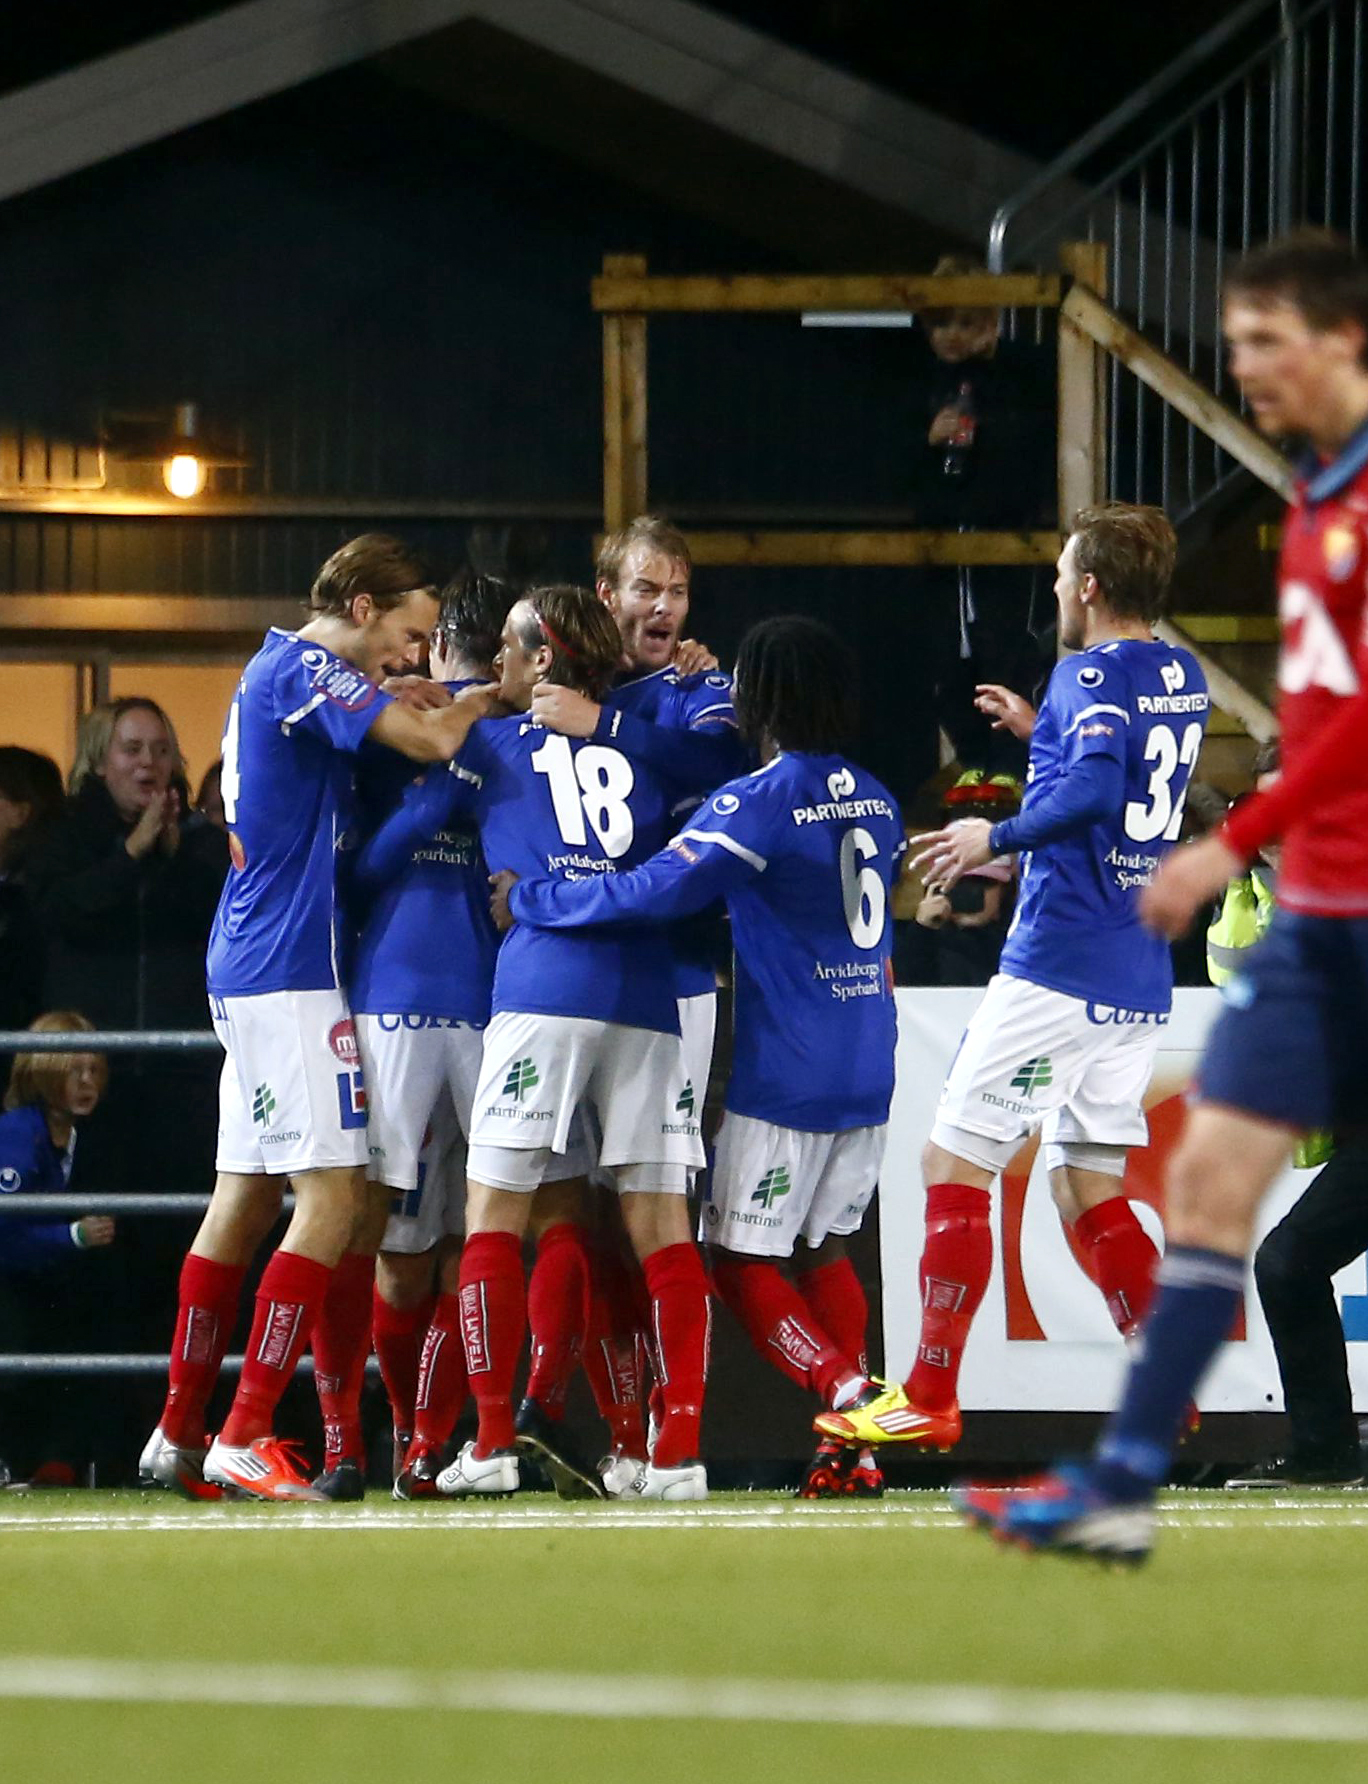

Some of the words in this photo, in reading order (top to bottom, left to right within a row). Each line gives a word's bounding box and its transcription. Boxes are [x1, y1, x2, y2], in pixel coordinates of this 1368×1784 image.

[531, 734, 634, 859] 18
[1124, 722, 1202, 842] 32
[840, 827, 886, 949] 6
[465, 1317, 483, 1370] TEAM
